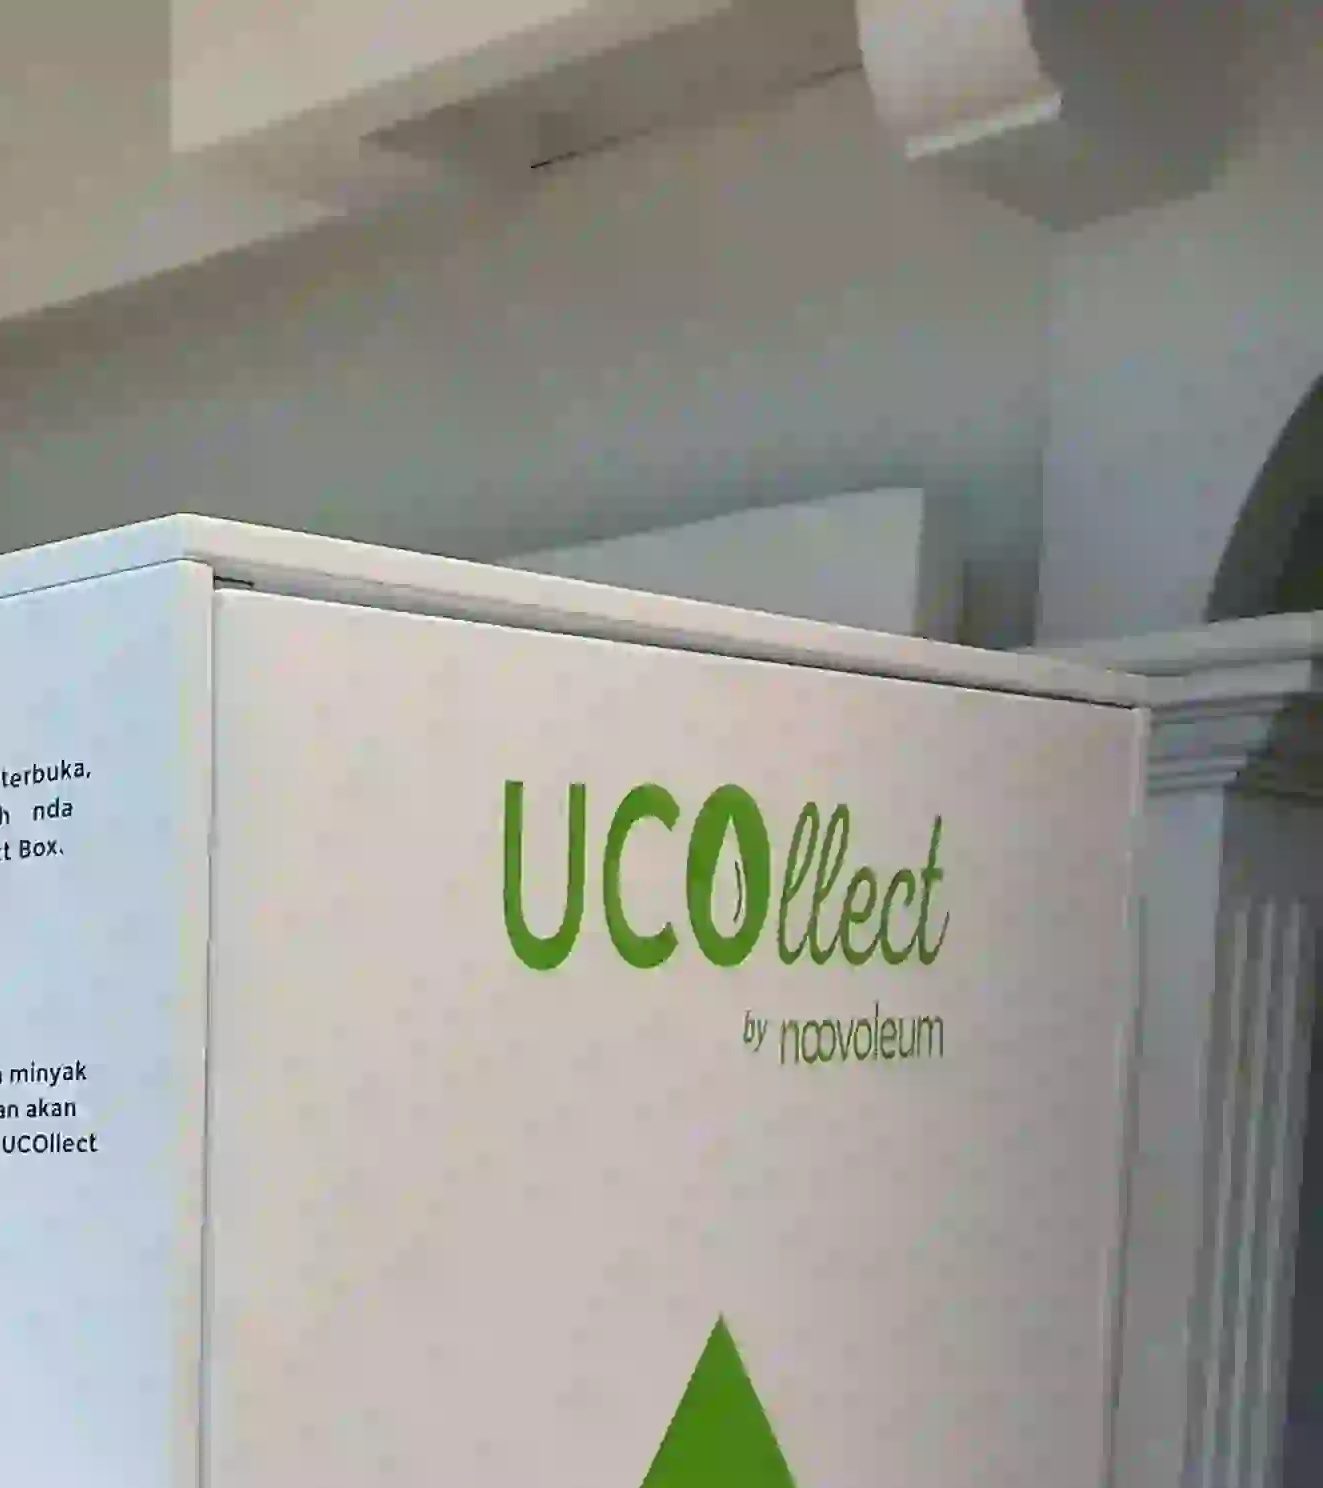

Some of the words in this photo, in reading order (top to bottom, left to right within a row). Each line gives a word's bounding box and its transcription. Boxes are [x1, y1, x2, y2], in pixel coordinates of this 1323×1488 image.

[2, 759, 92, 789] terbuka,
[19, 839, 65, 859] Box.
[502, 778, 951, 972] UCOllect
[743, 1009, 769, 1052] by
[780, 1000, 944, 1065] noovoleum
[10, 1060, 88, 1088] minyak
[26, 1098, 76, 1118] akan
[2, 1131, 99, 1154] UCOllect
